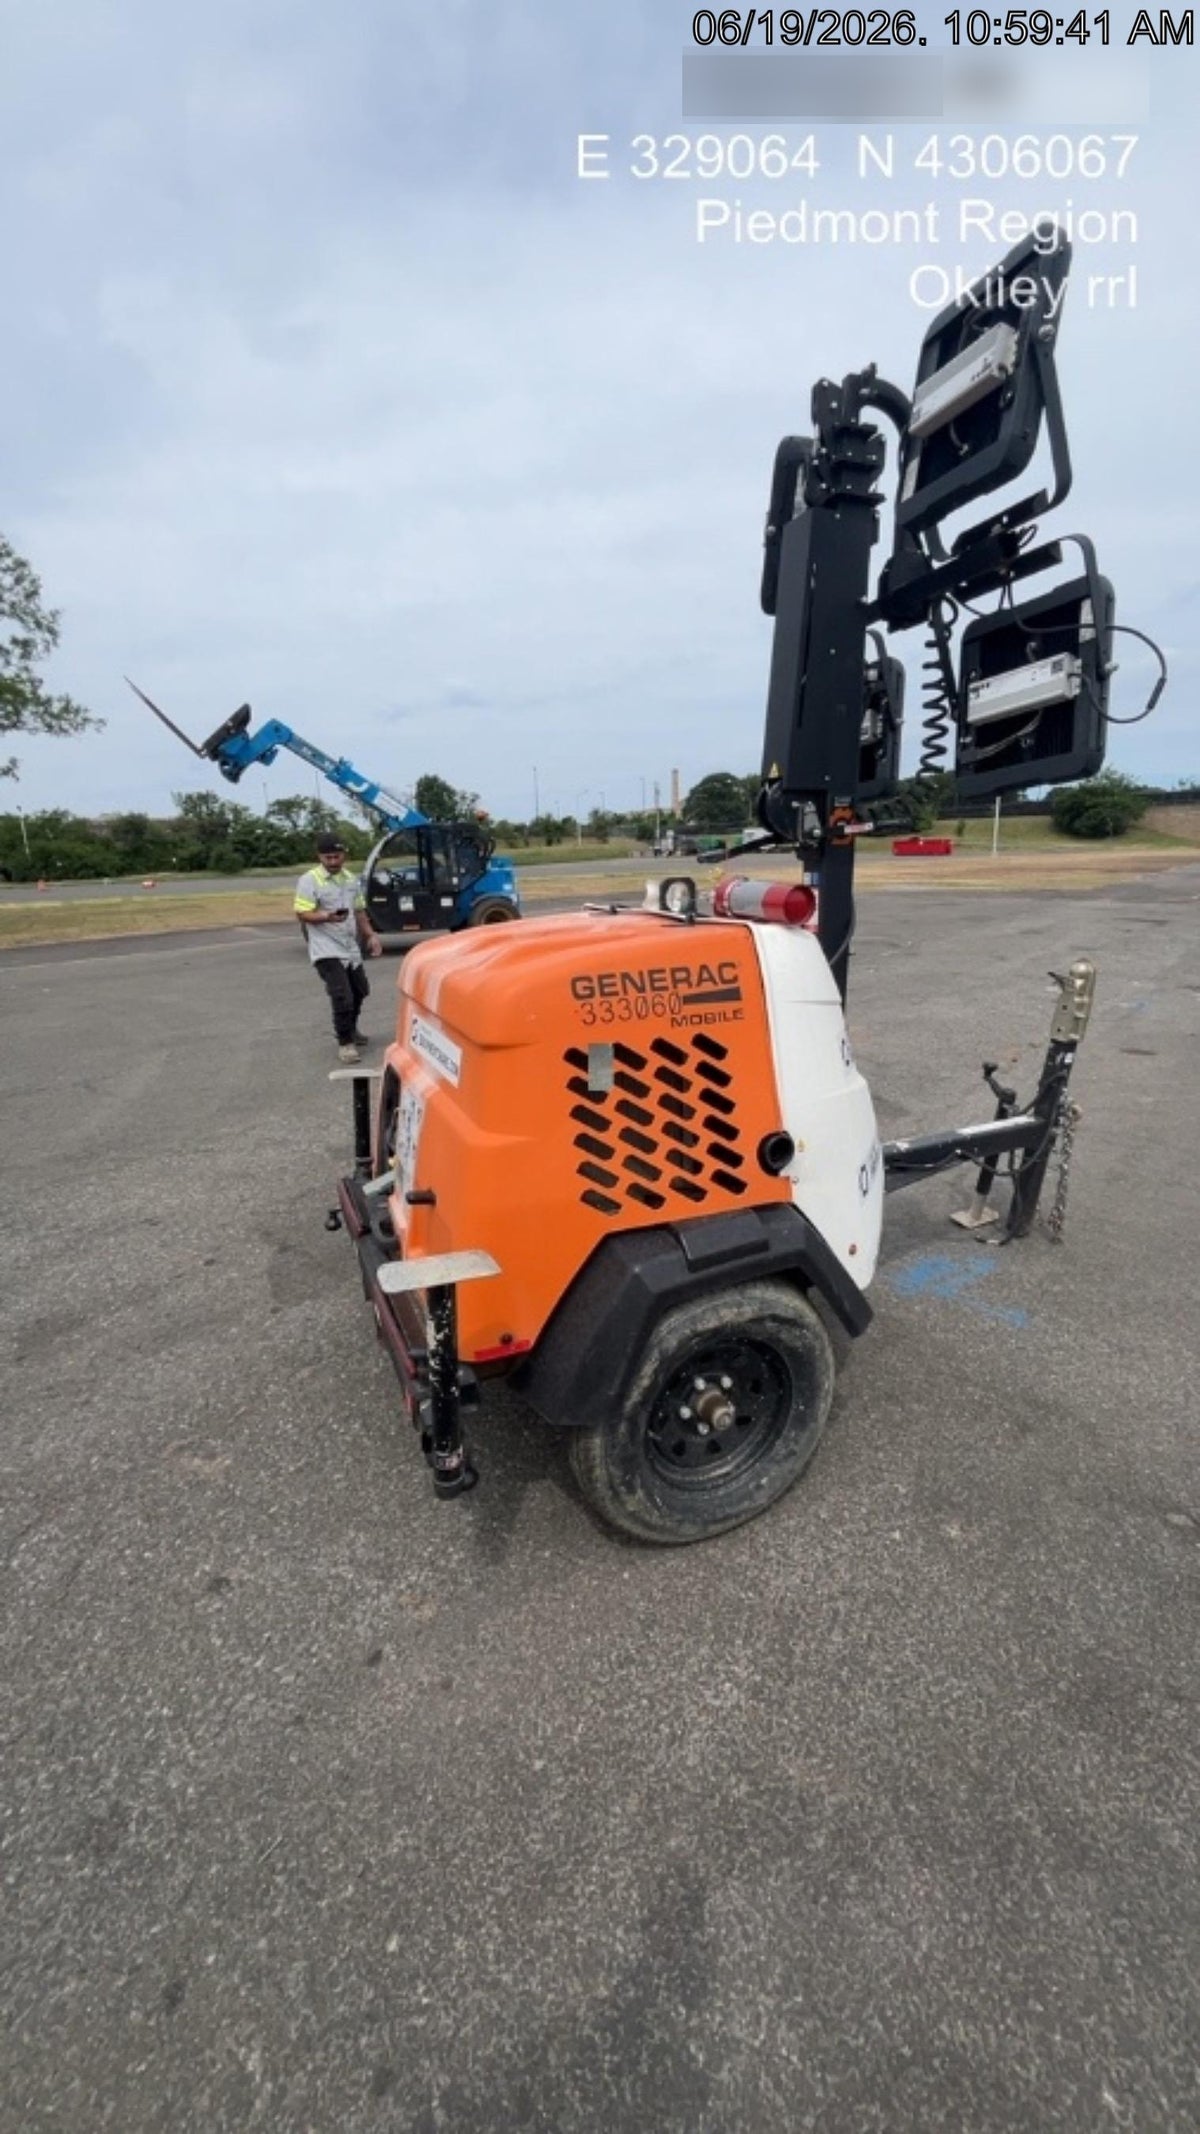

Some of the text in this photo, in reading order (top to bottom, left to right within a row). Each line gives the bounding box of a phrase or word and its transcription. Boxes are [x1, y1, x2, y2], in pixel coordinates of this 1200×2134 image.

[570, 962, 739, 1001] GENERAC
[579, 991, 682, 1026] 333060
[670, 1008, 744, 1028] MOBILE
